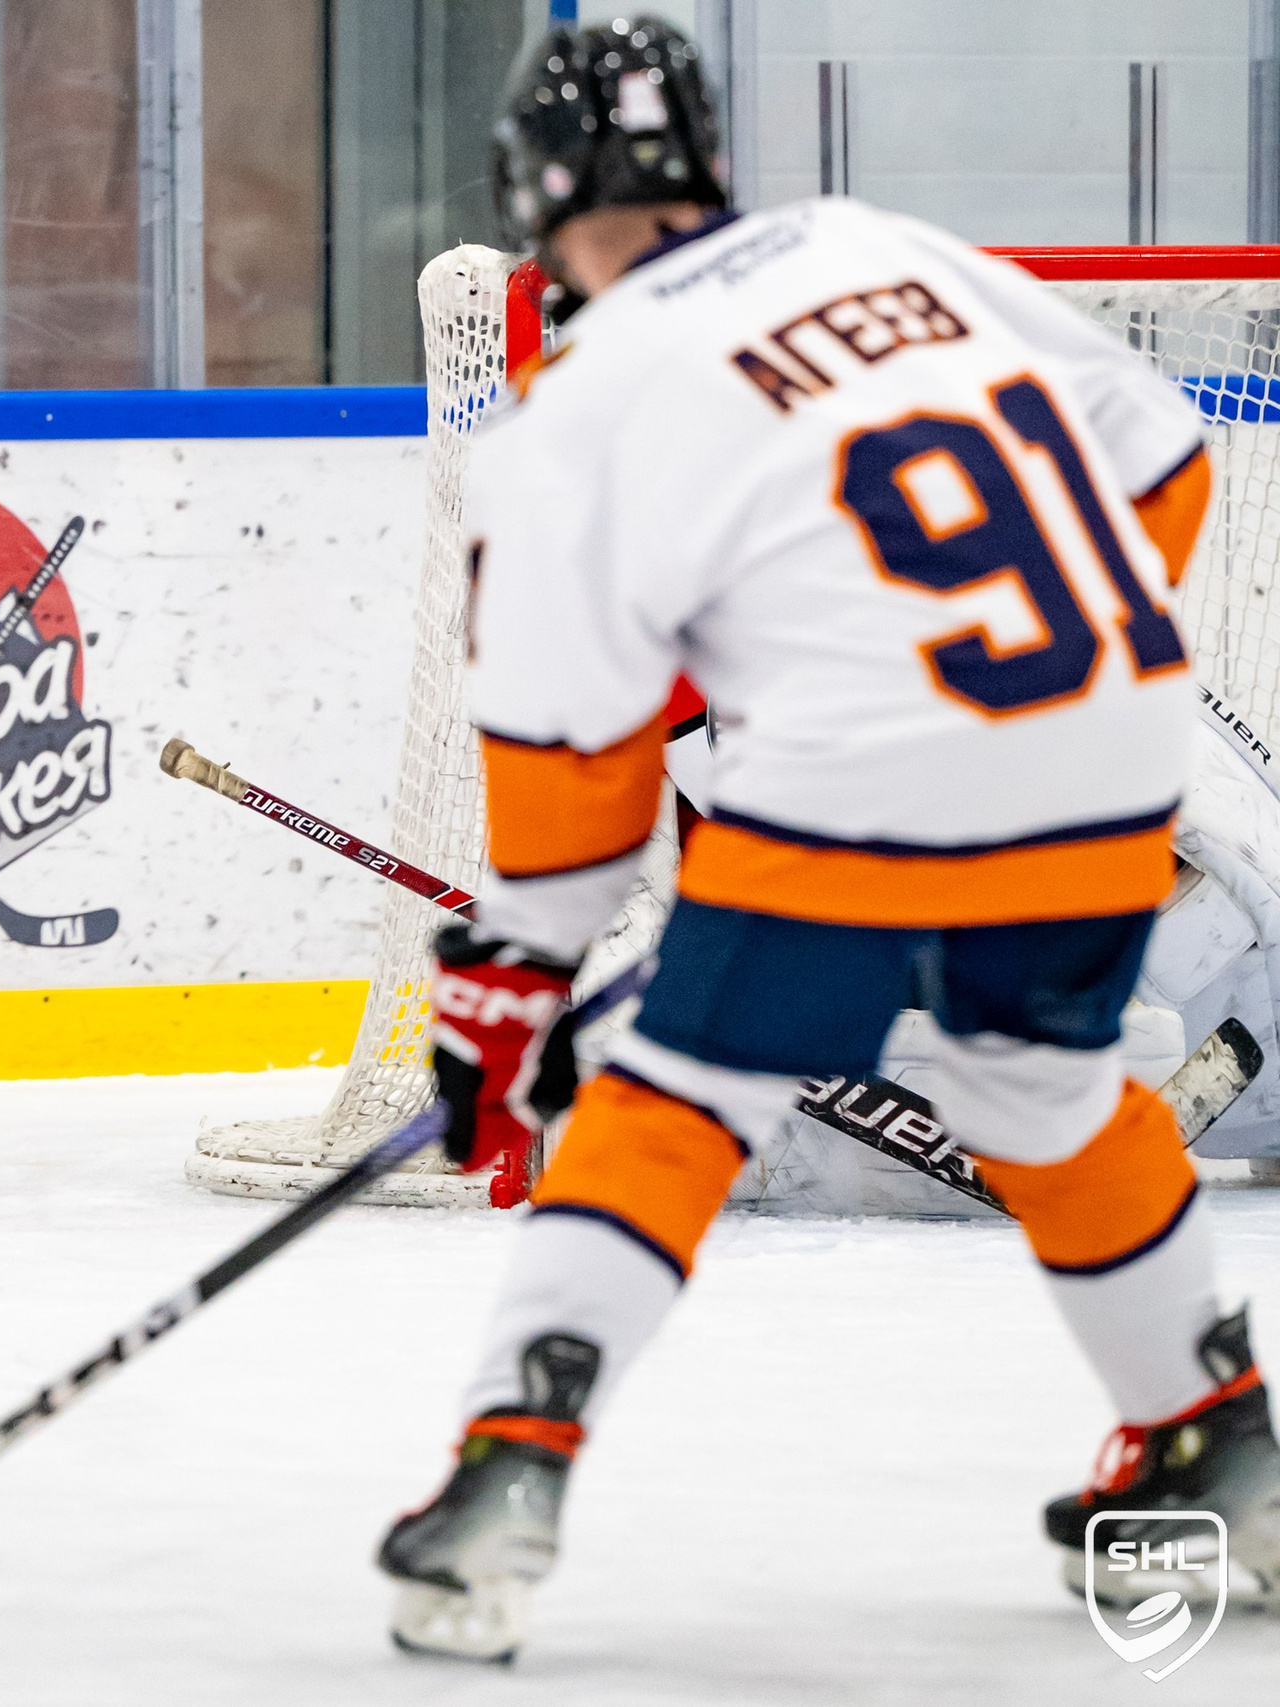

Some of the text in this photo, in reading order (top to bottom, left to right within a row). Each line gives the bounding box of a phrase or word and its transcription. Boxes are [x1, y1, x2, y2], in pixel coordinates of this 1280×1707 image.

[731, 279, 970, 411] АГЕЕВ
[833, 371, 1189, 719] 91
[353, 847, 398, 876] S27
